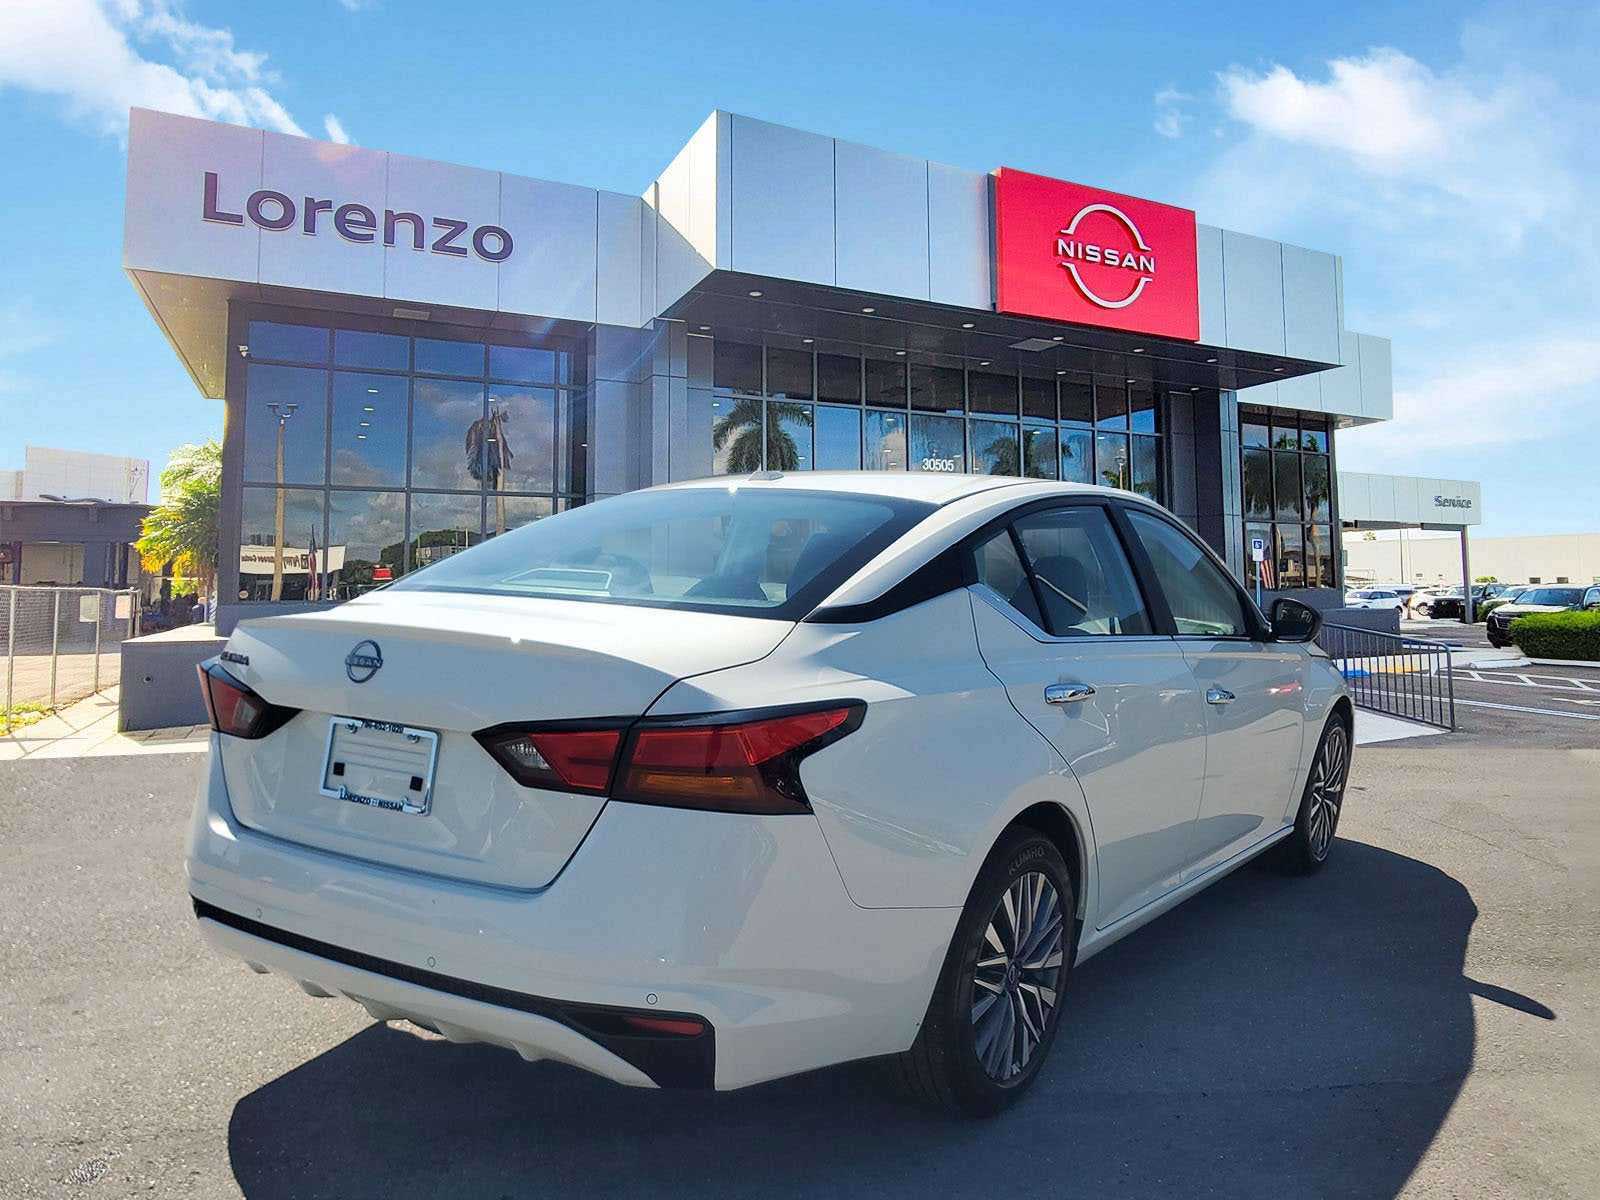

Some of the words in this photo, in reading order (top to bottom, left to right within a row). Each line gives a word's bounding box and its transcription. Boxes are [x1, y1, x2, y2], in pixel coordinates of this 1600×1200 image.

[202, 171, 514, 262] Lorenzo
[1057, 238, 1155, 273] NISSAN
[922, 457, 954, 471] 30505
[1434, 495, 1472, 508] Service
[378, 799, 404, 812] NISSAN
[1008, 845, 1045, 876] KUMHO
